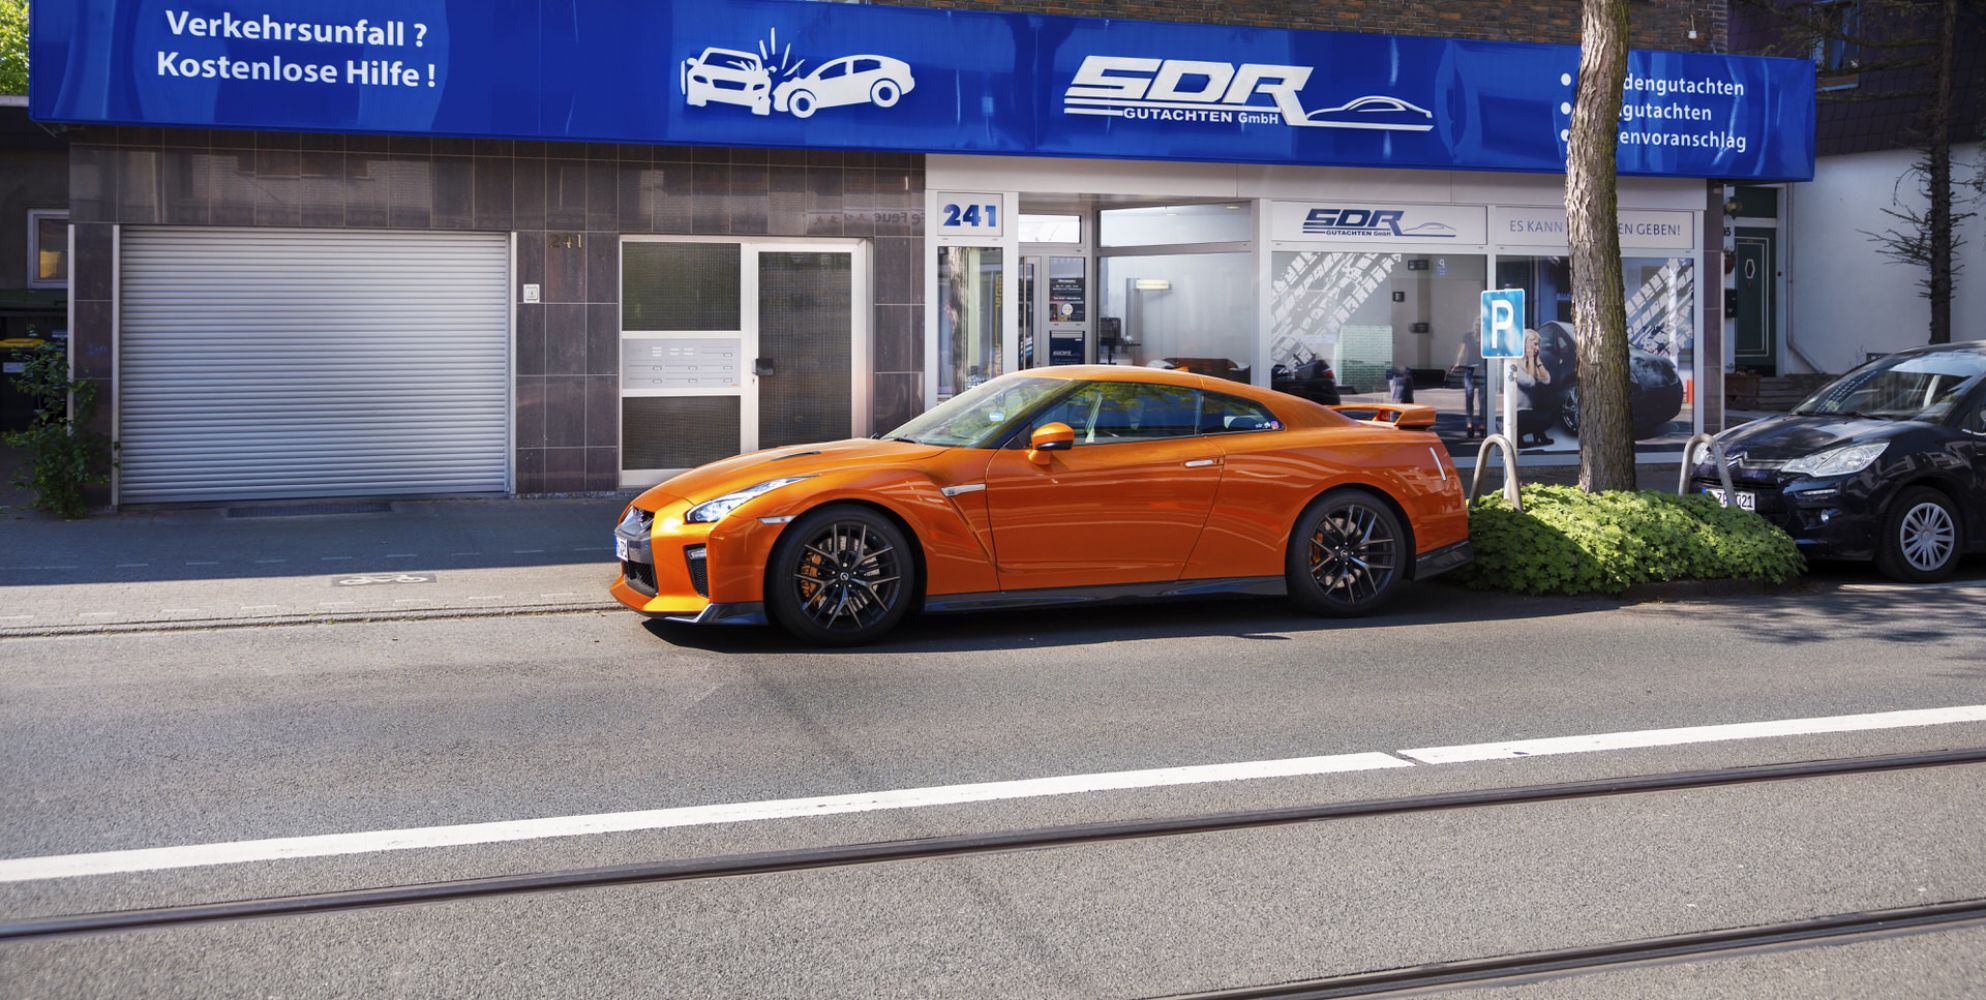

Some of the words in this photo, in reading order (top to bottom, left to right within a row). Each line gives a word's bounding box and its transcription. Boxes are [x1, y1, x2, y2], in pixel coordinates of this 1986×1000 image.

[165, 10, 404, 46] Verkehrsunfall
[414, 23, 428, 48] ?
[157, 51, 338, 84] Kostenlose
[346, 60, 420, 87] Hilfe
[427, 63, 436, 88] !
[1064, 55, 1314, 125] SDR
[1623, 73, 1744, 97] dengutachten
[1123, 107, 1233, 123] GUTACHTEN
[1238, 112, 1279, 124] GmbH
[1619, 102, 1712, 122] gutachten
[1619, 130, 1747, 153] envoranschlag
[943, 204, 997, 228] 241
[1302, 208, 1405, 237] SDR
[1510, 220, 1524, 232] ES
[1527, 221, 1563, 233] KANN
[1636, 224, 1681, 236] GEBEN!
[1491, 299, 1514, 349] P
